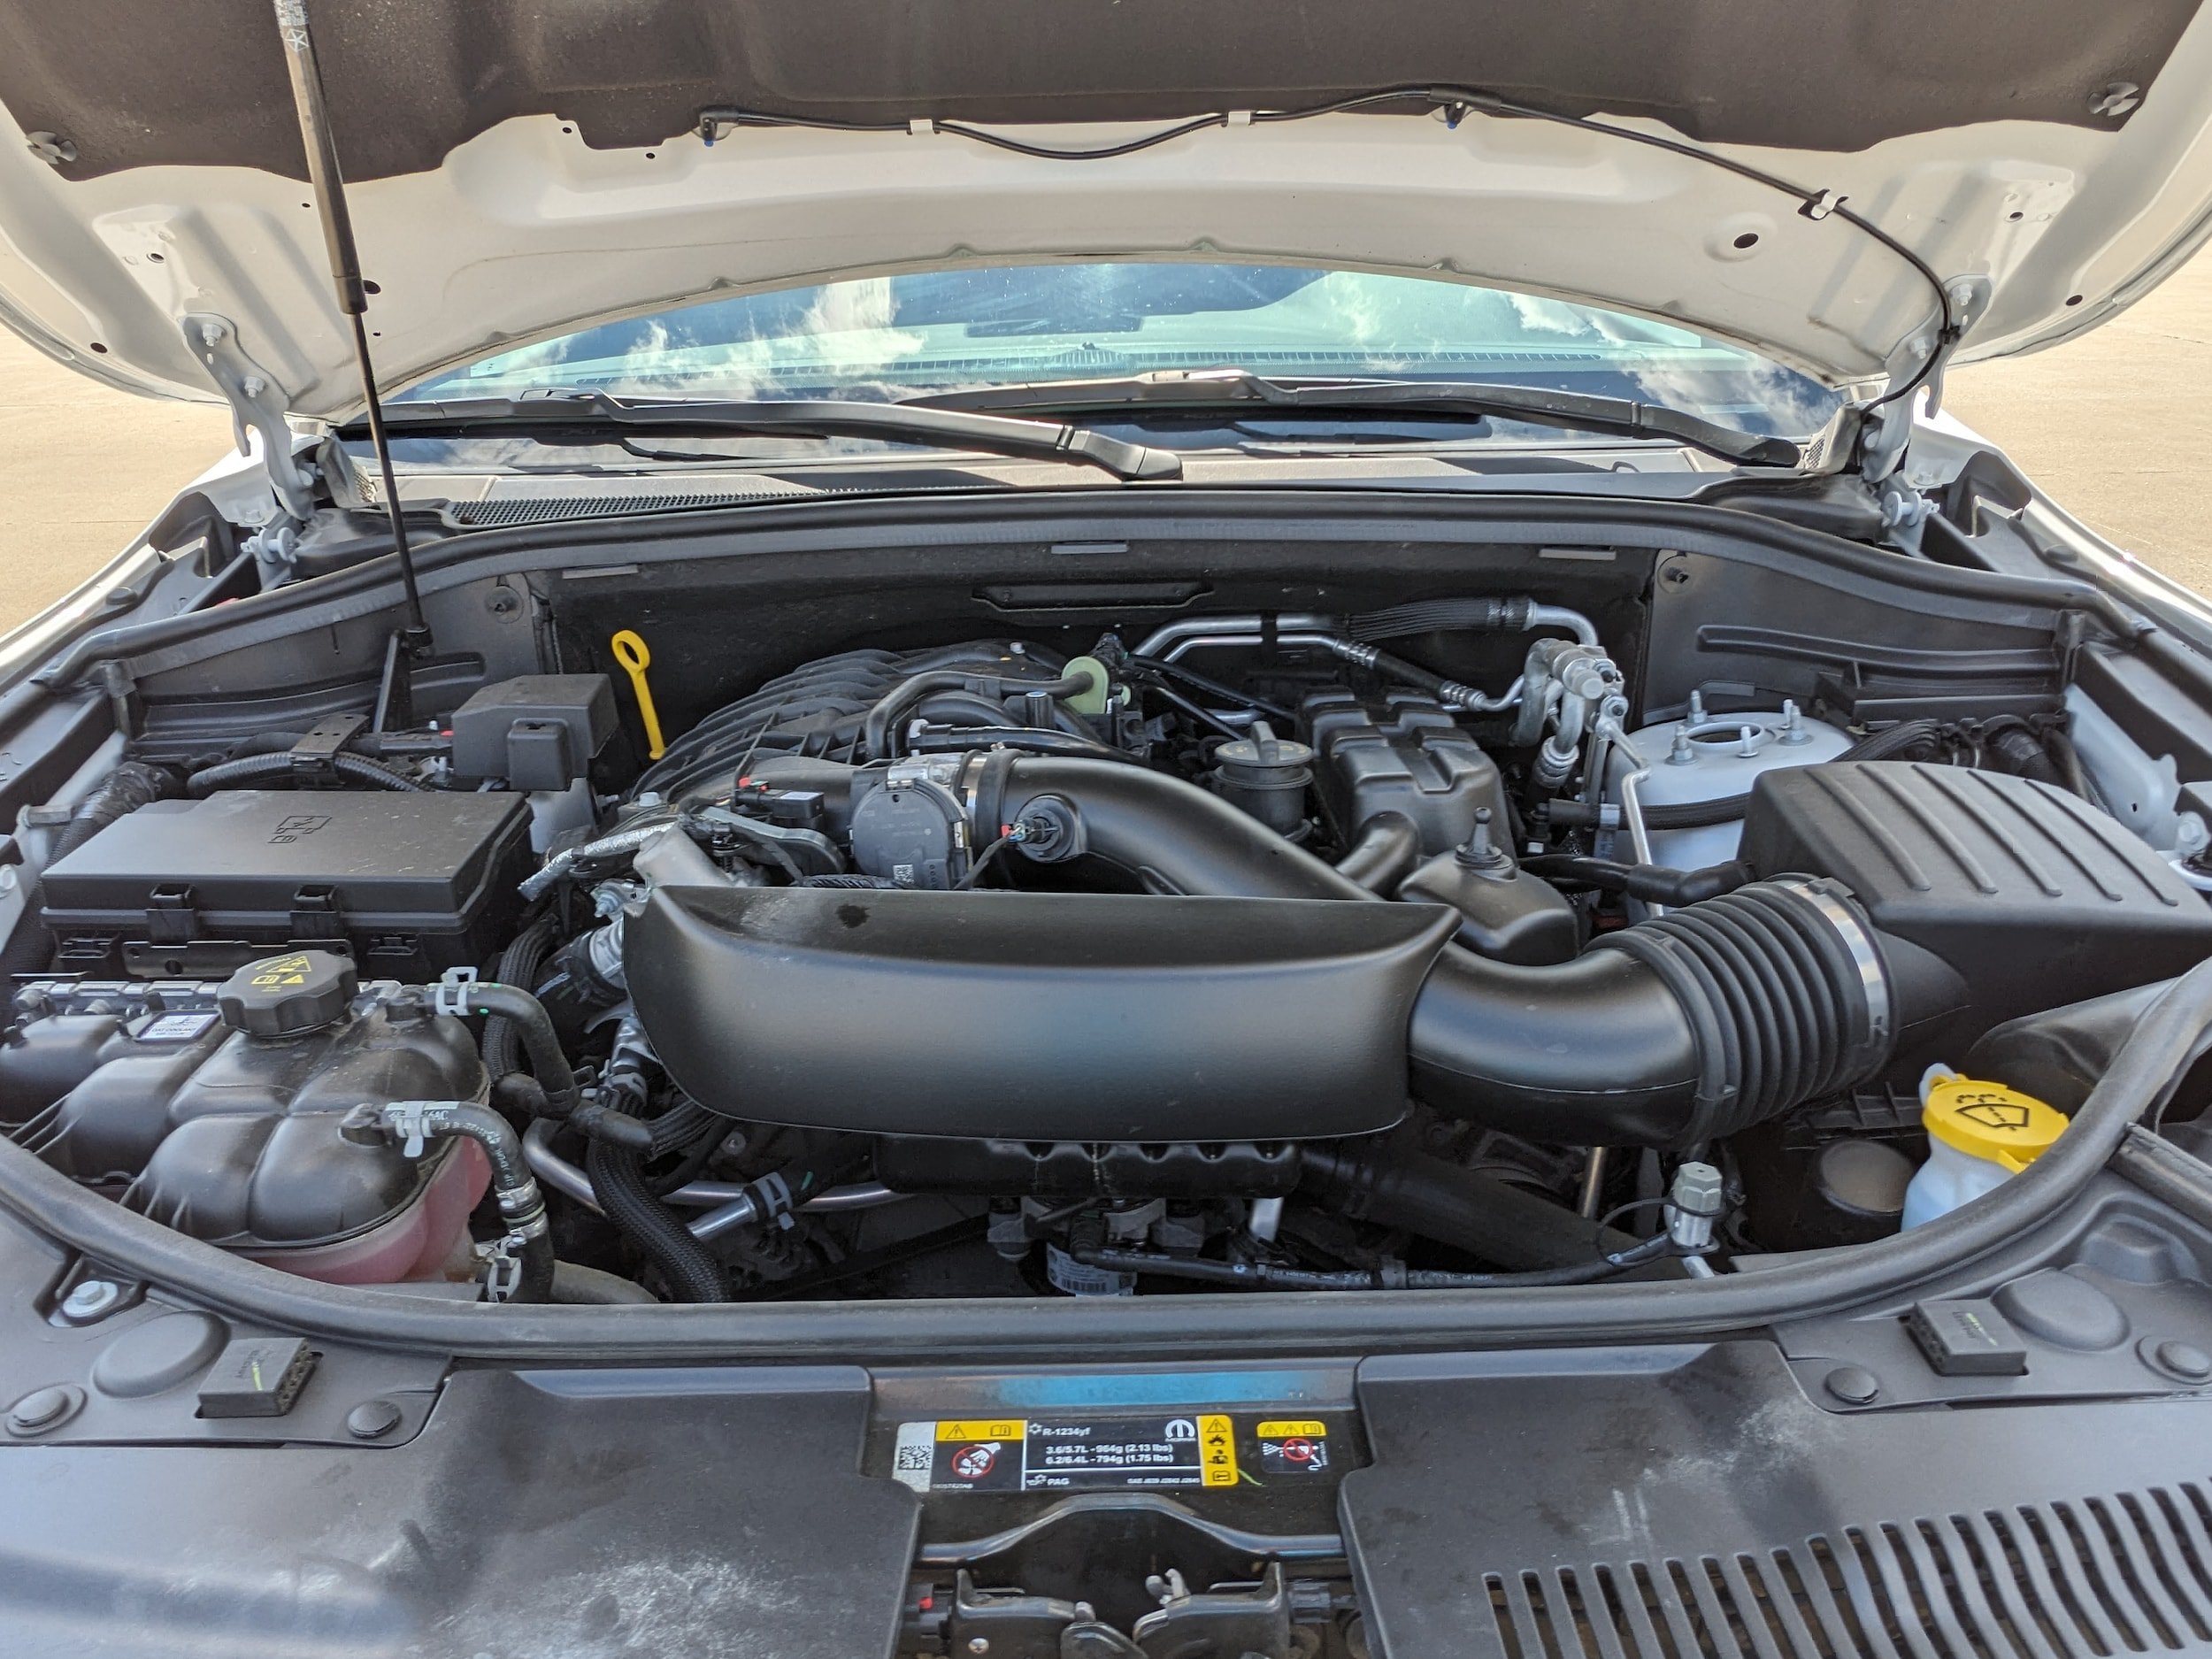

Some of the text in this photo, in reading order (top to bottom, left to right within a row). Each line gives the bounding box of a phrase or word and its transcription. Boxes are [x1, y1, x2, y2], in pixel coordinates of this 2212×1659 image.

[1042, 1426, 1091, 1437] R-1234yf
[1045, 1445, 1089, 1455] 3.6/5.7L
[1125, 1443, 1151, 1454] (2.13
[1152, 1443, 1174, 1453] lbs)
[1125, 1454, 1151, 1463] (1.75
[1152, 1454, 1174, 1463] lbs)
